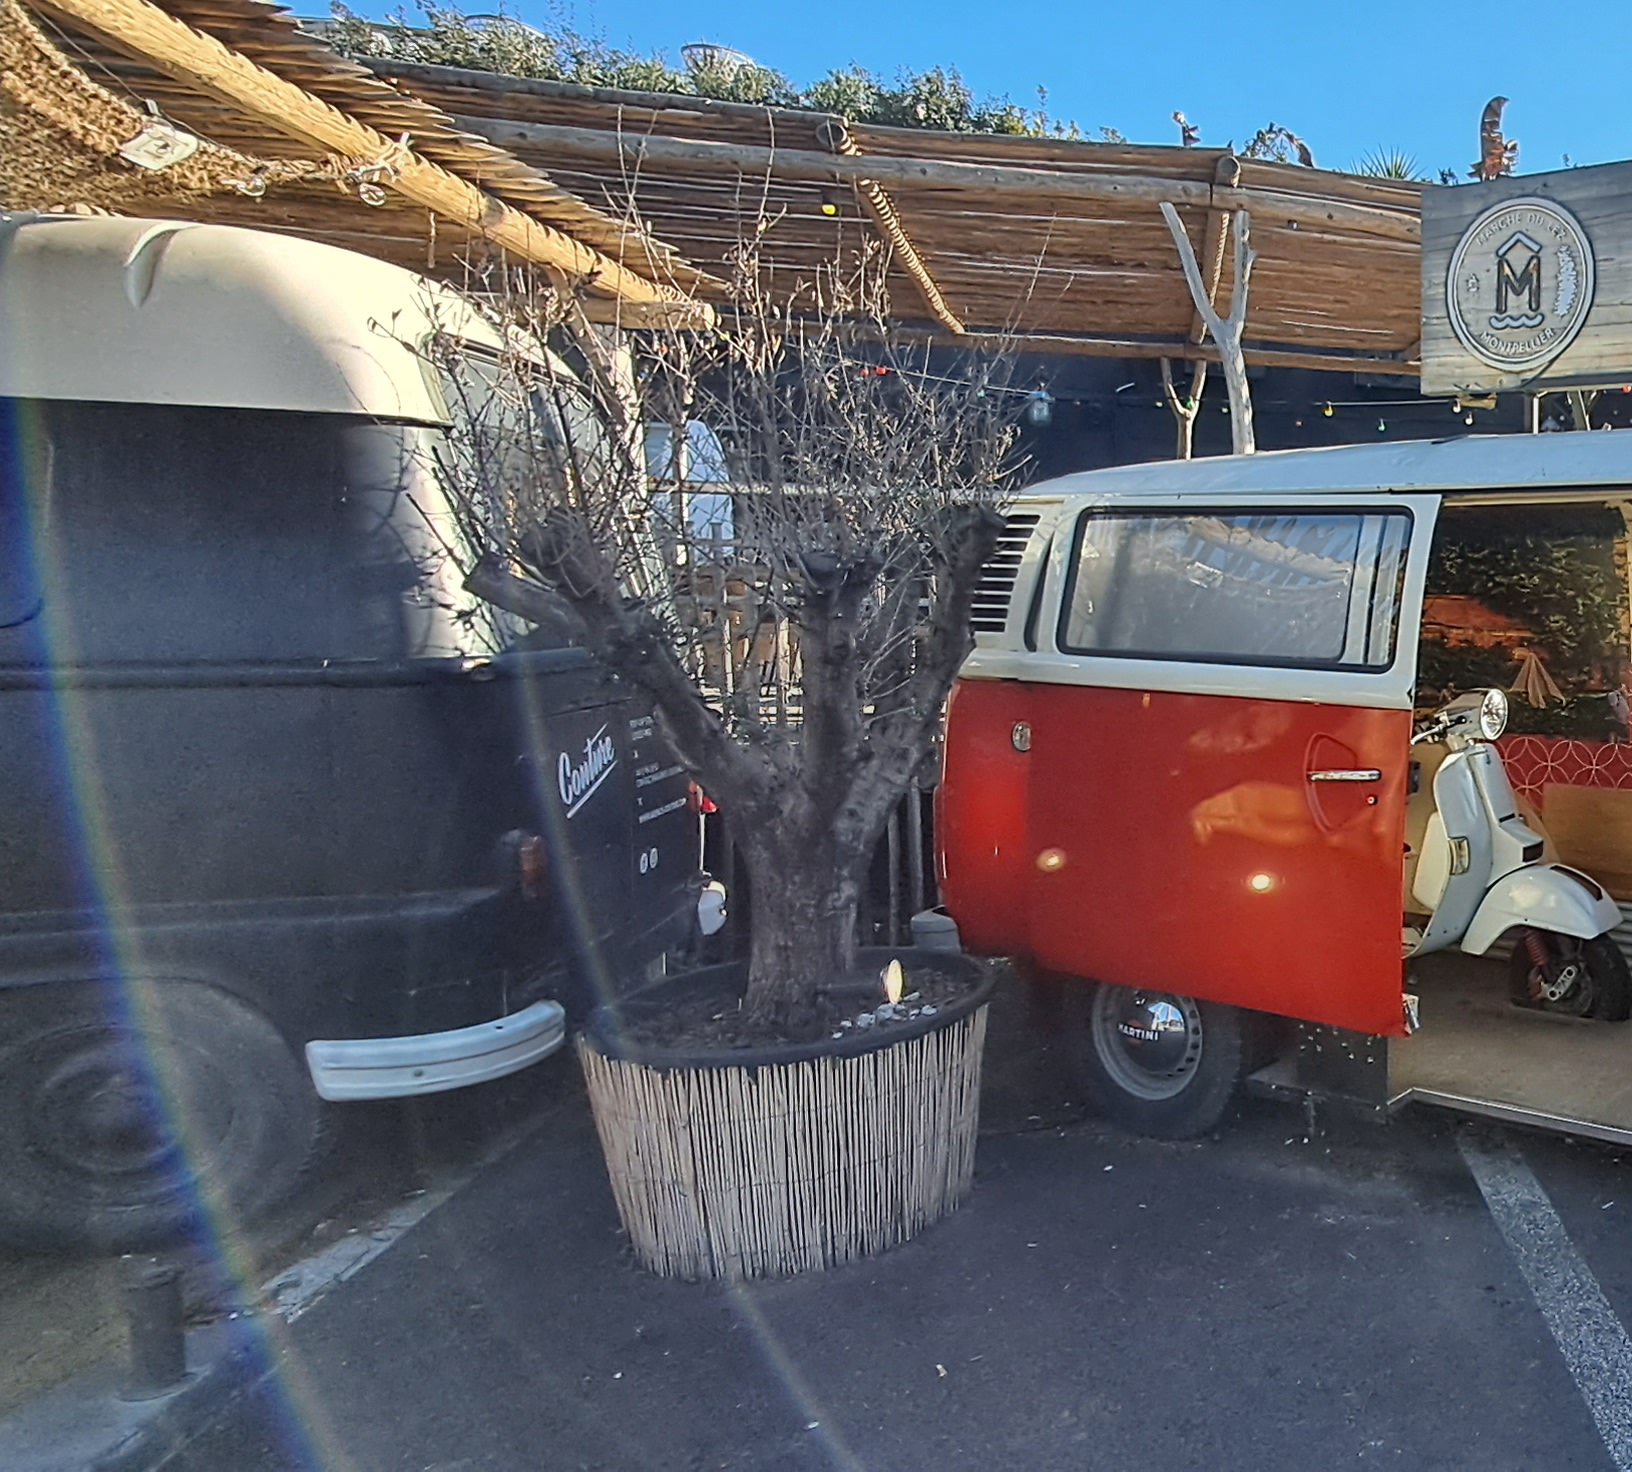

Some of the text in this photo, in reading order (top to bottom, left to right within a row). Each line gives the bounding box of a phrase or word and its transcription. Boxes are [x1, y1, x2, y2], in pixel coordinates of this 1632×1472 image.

[1526, 213, 1545, 226] DU
[1480, 327, 1555, 354] MONTPELLIER
[1118, 1023, 1159, 1041] MARTINI
